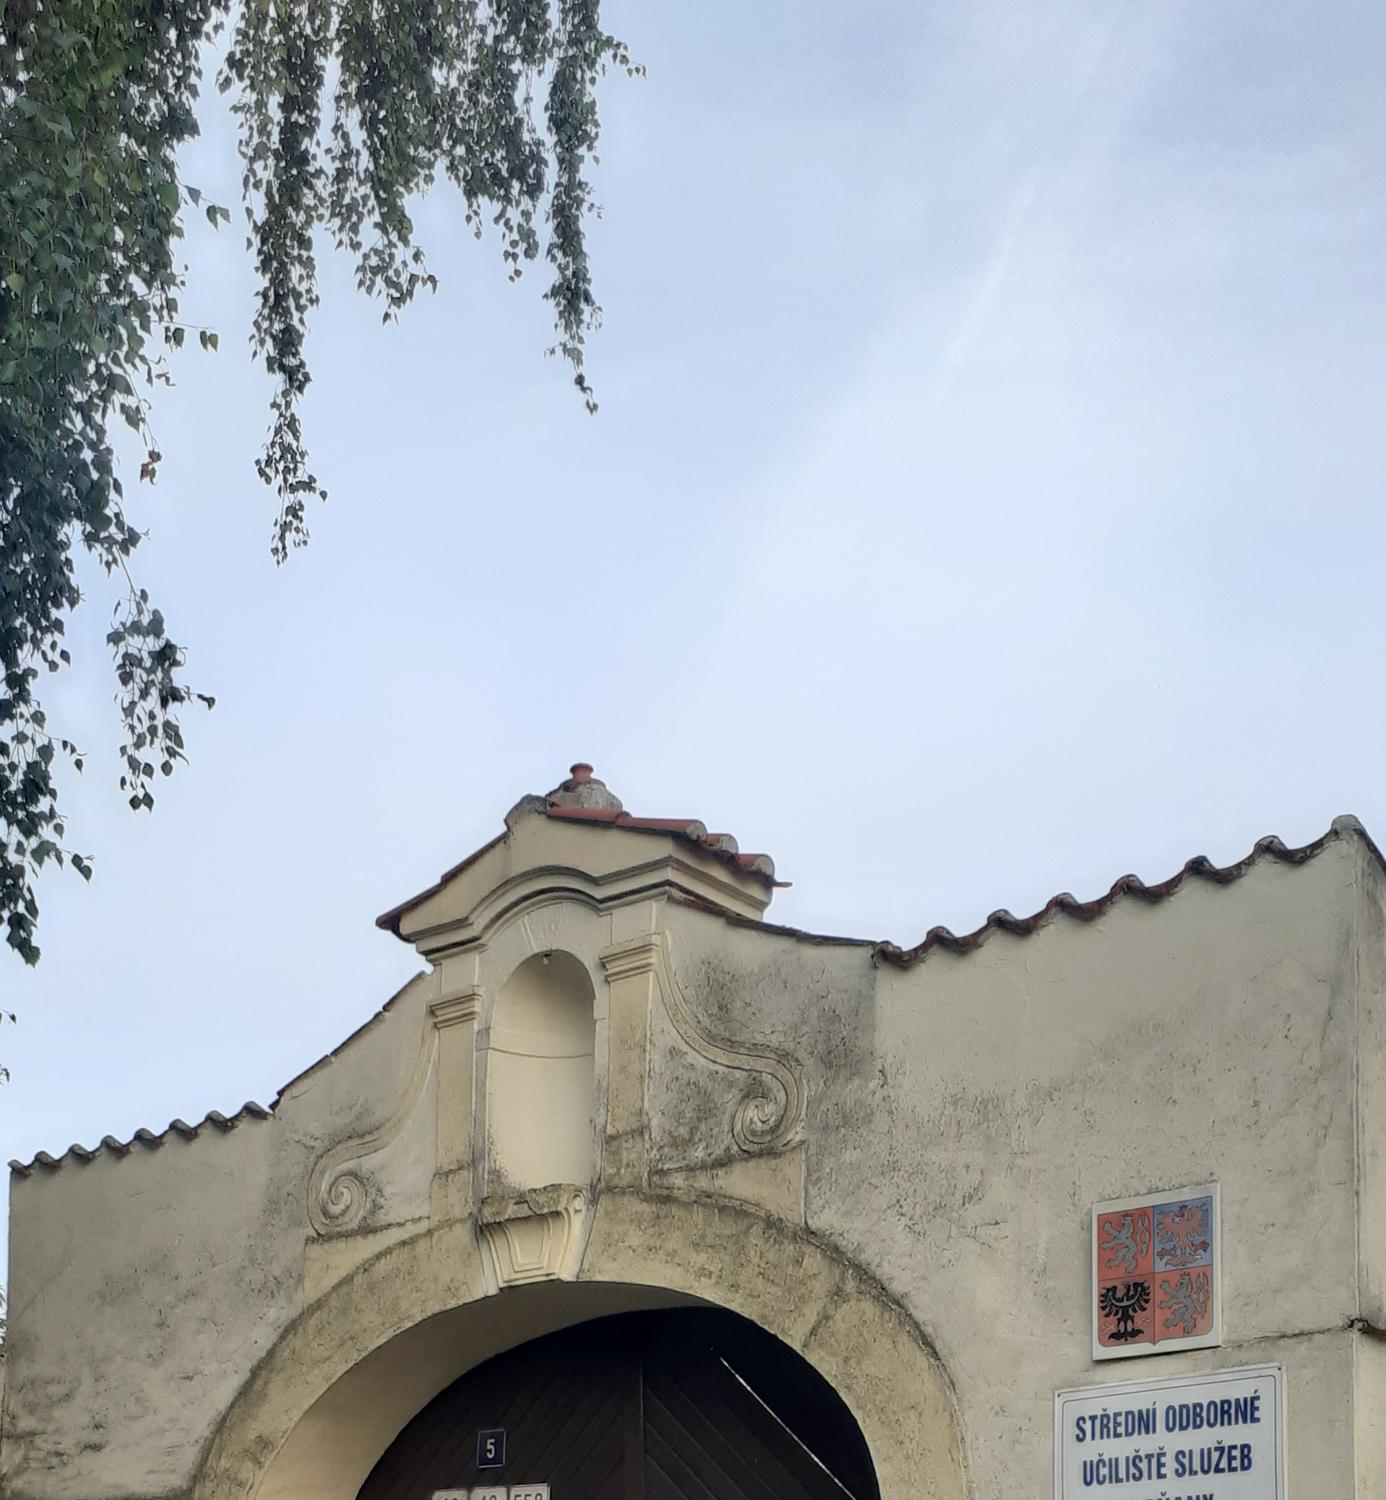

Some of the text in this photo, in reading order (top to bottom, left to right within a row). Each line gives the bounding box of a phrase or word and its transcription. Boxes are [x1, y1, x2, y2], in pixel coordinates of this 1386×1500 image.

[1075, 1389, 1261, 1443] STŘEDNÍ ODBORNÉ
[486, 1438, 496, 1459] 5
[1083, 1440, 1253, 1487] UČILIŠTĚ SLUŽEB
